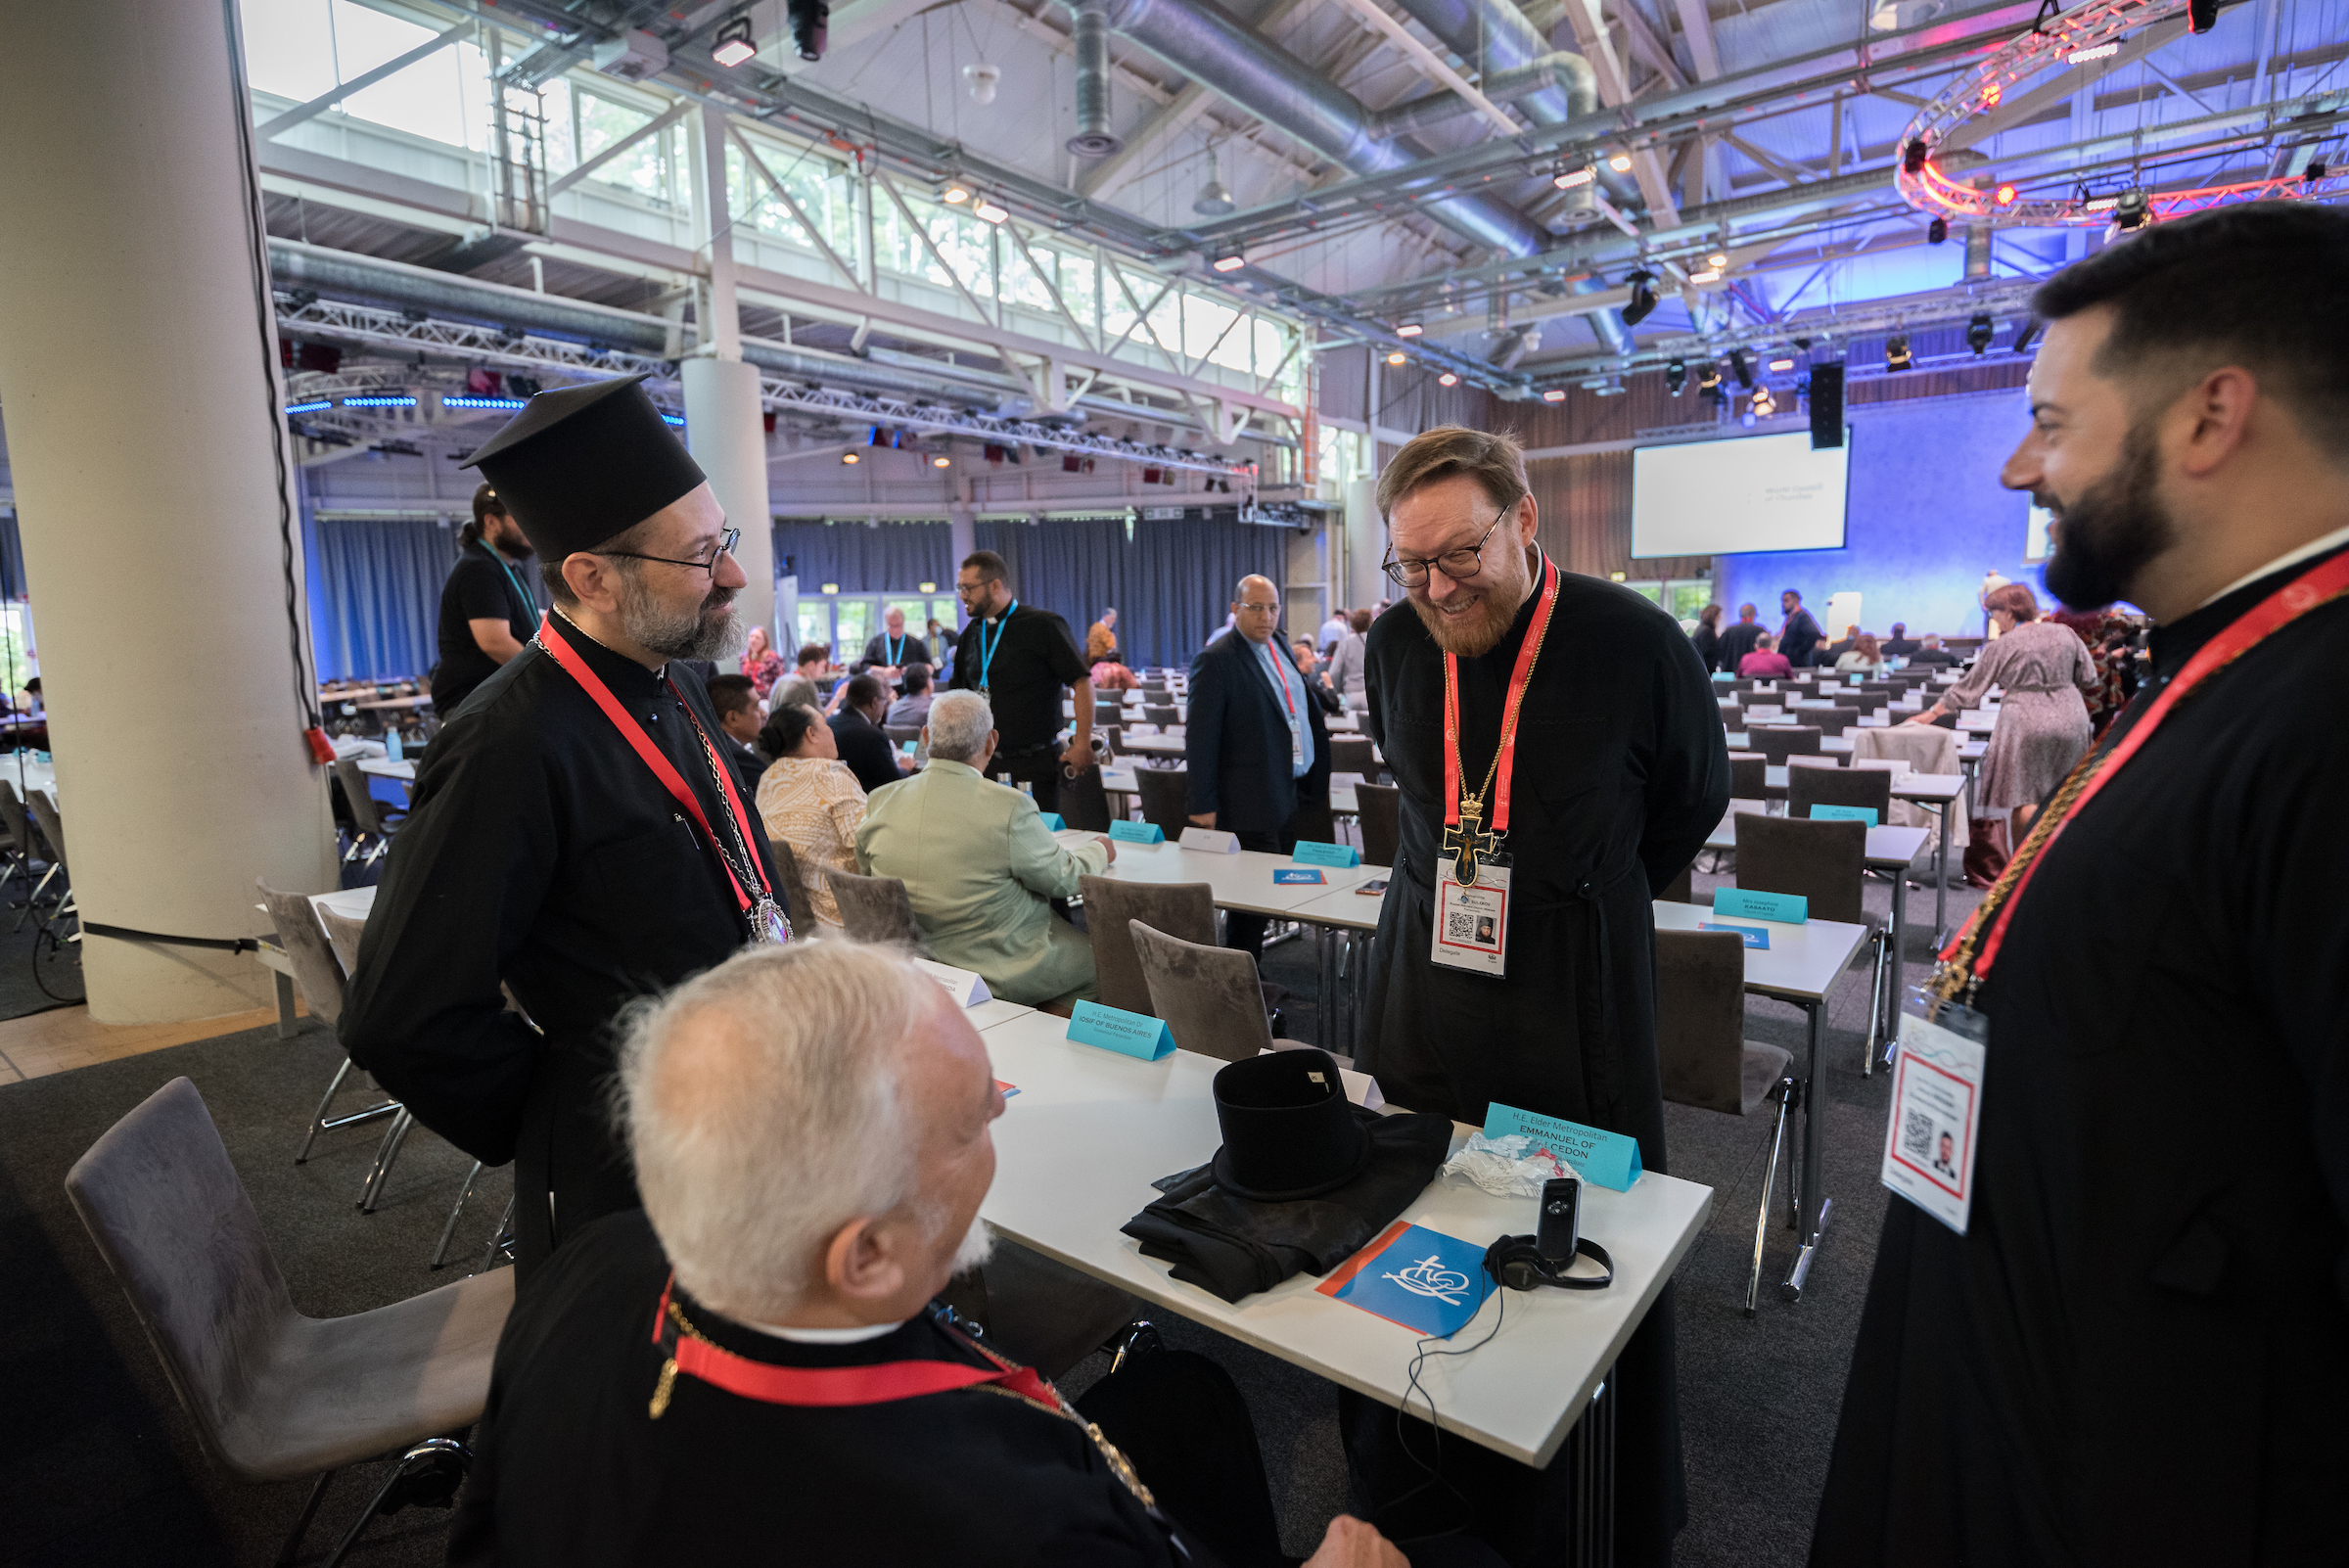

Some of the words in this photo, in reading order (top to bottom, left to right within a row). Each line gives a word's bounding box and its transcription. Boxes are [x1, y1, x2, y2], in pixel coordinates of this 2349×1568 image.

[1439, 947, 1460, 956] Delegate
[1103, 1013, 1135, 1025] Metropolitan
[1105, 1023, 1132, 1033] BUENOS
[1132, 1030, 1152, 1038] AIRES
[1512, 1112, 1528, 1123] H.E.
[1531, 1117, 1550, 1128] Elder
[1552, 1123, 1607, 1141] Metropolitan
[1520, 1125, 1580, 1146] EMMANUEL
[1581, 1140, 1595, 1149] OF
